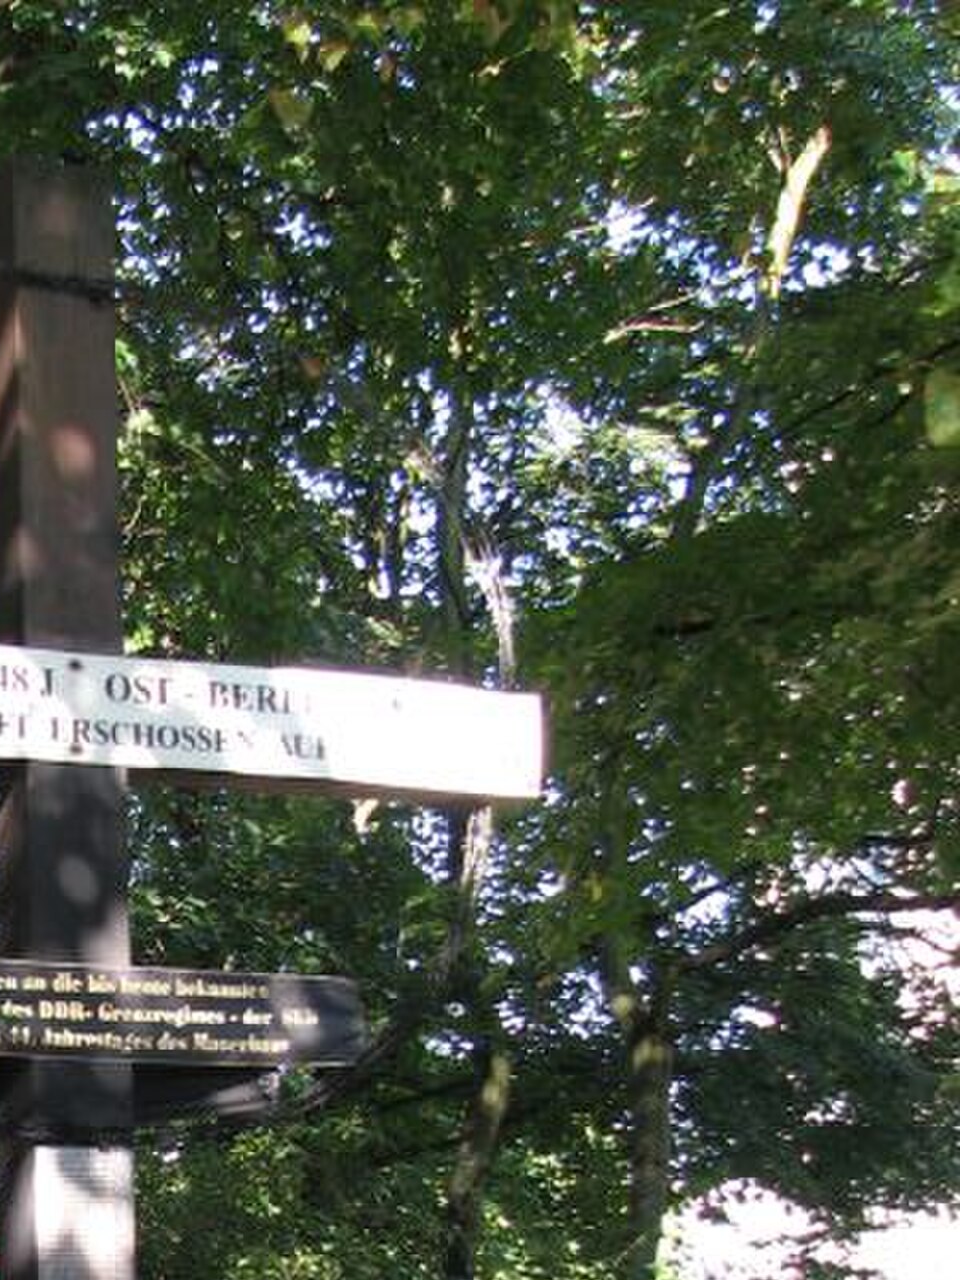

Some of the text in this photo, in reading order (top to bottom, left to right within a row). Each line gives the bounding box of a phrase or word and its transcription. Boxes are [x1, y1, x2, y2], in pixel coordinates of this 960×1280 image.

[105, 673, 172, 706] OST
[21, 975, 47, 991] an
[1, 999, 34, 1018] des
